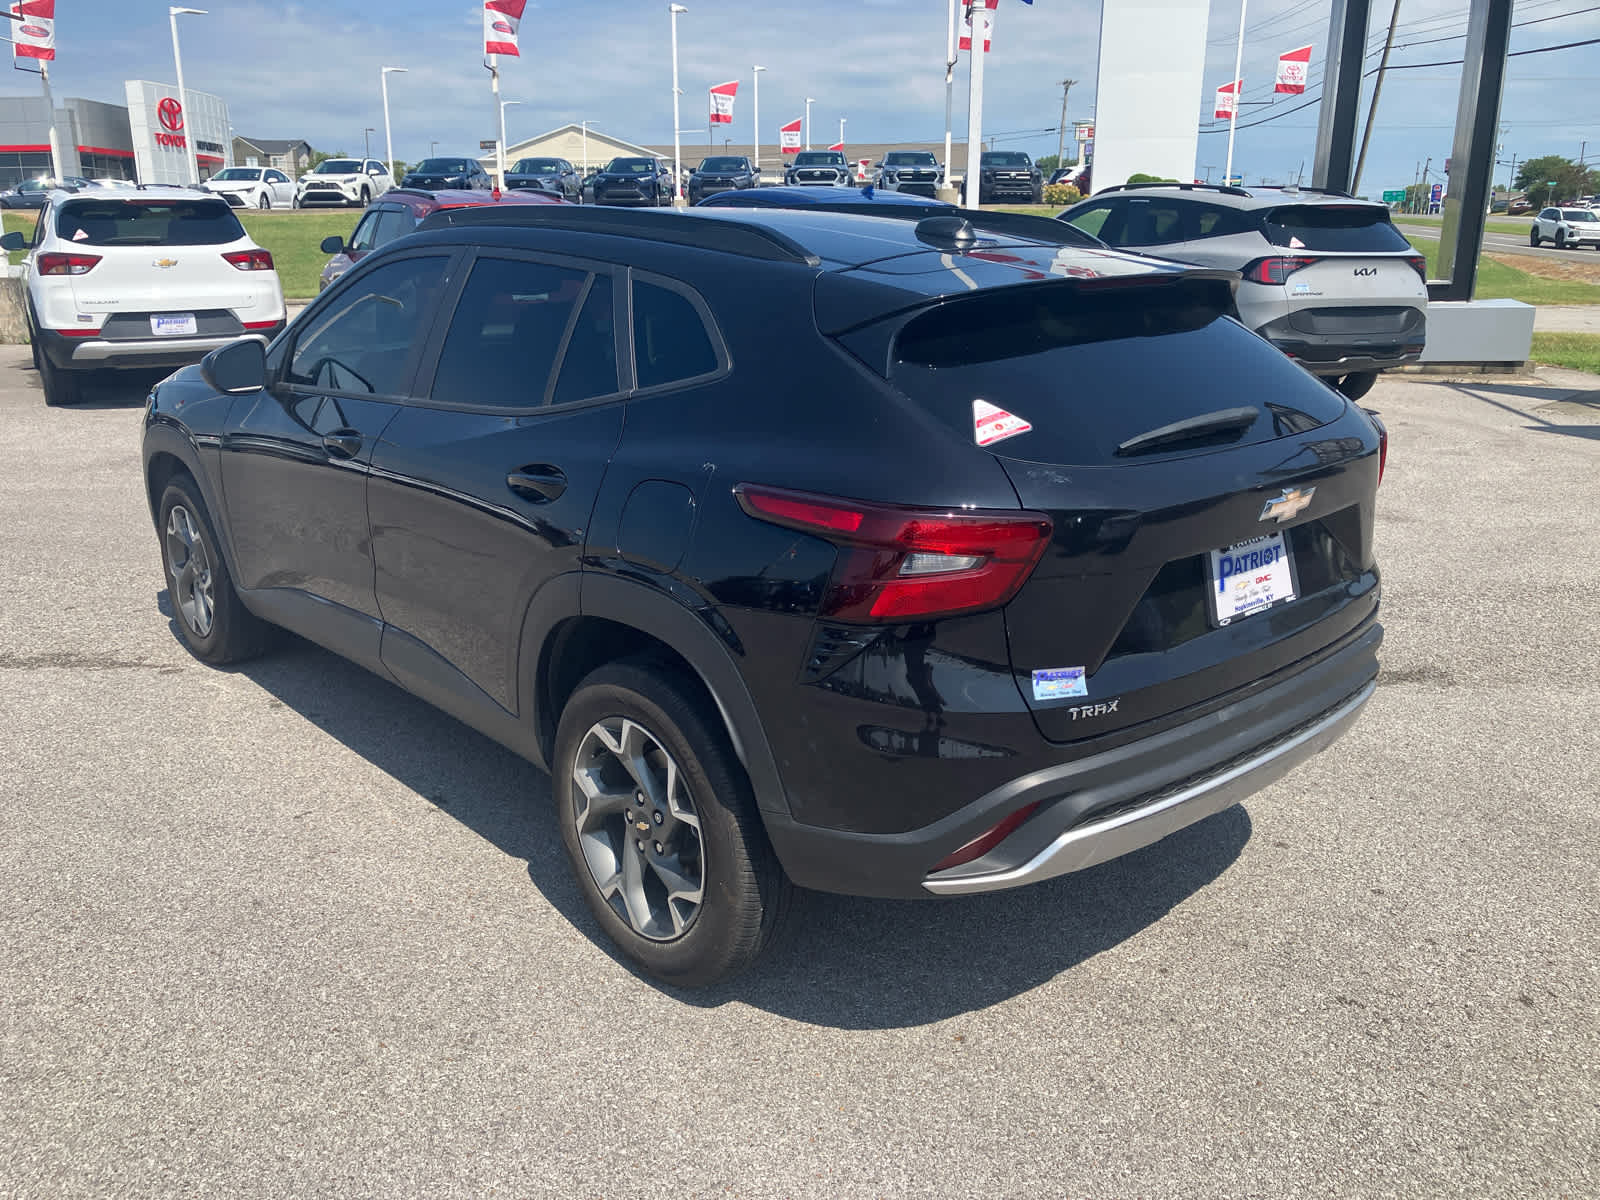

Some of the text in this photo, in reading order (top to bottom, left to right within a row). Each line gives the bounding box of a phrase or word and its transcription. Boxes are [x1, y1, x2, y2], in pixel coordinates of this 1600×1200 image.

[154, 132, 187, 148] TOYOT
[1354, 268, 1377, 276] KIA
[157, 317, 189, 328] PATRIOT
[1219, 545, 1281, 592] PATRIOT
[1256, 574, 1272, 584] GMC
[1036, 670, 1083, 687] PATRIOT
[1068, 698, 1120, 720] TRAX
